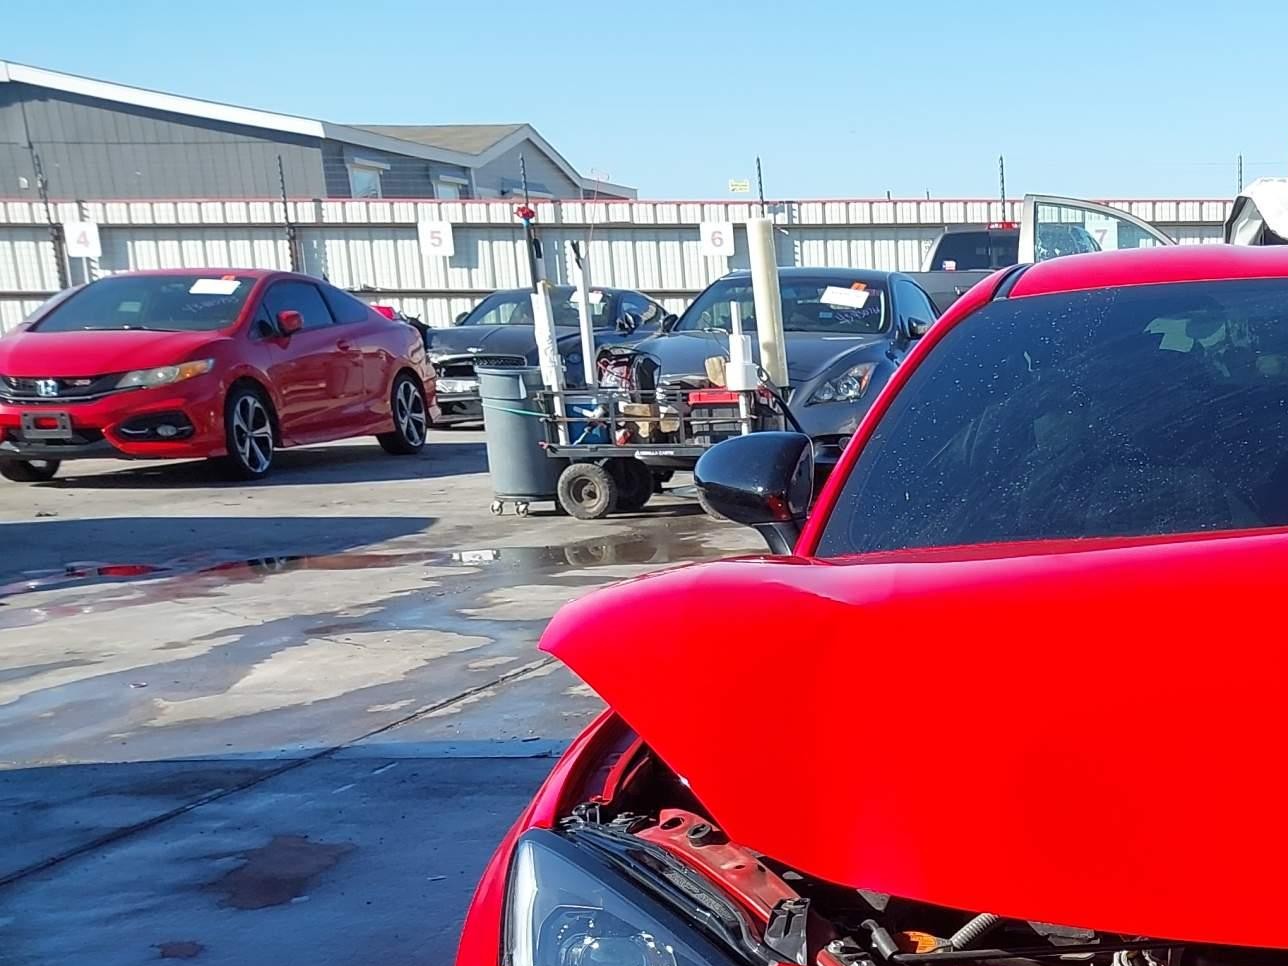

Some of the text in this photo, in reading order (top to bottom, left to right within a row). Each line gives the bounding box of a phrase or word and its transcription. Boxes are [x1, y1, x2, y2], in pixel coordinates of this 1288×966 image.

[76, 230, 90, 248] 4
[430, 230, 443, 247] 5
[711, 230, 724, 247] 6
[1095, 229, 1108, 246] 7
